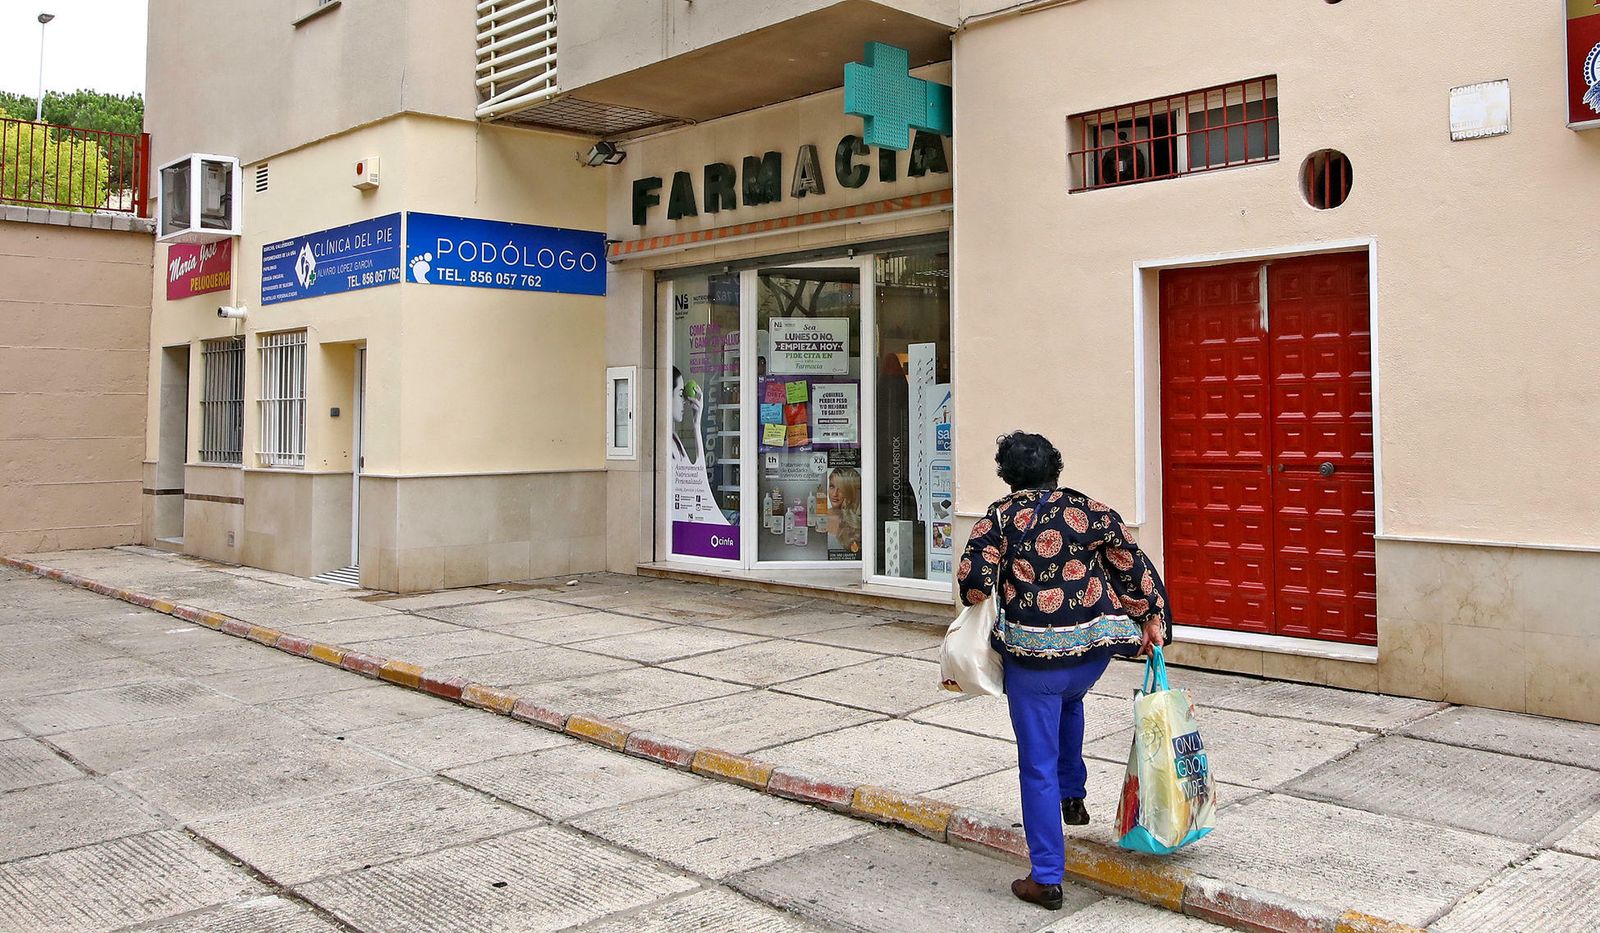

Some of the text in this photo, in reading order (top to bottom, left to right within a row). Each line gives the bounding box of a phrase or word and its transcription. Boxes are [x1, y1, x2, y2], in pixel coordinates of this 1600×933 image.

[632, 129, 949, 226] FARMACIA
[314, 227, 393, 258] CLÍNICA DEL PIE
[437, 237, 597, 273] PODÓLOGO
[347, 267, 400, 288] TEL. 856 057 762
[437, 267, 542, 287] TEL. 856 057 762
[689, 338, 694, 348] Y
[785, 333, 810, 341] LUNES
[819, 333, 834, 341] NO,
[768, 456, 777, 464] th
[892, 436, 901, 517] MAGIC COLOURSTICK
[1175, 734, 1203, 754] ONLY
[1177, 755, 1208, 777] GOOD
